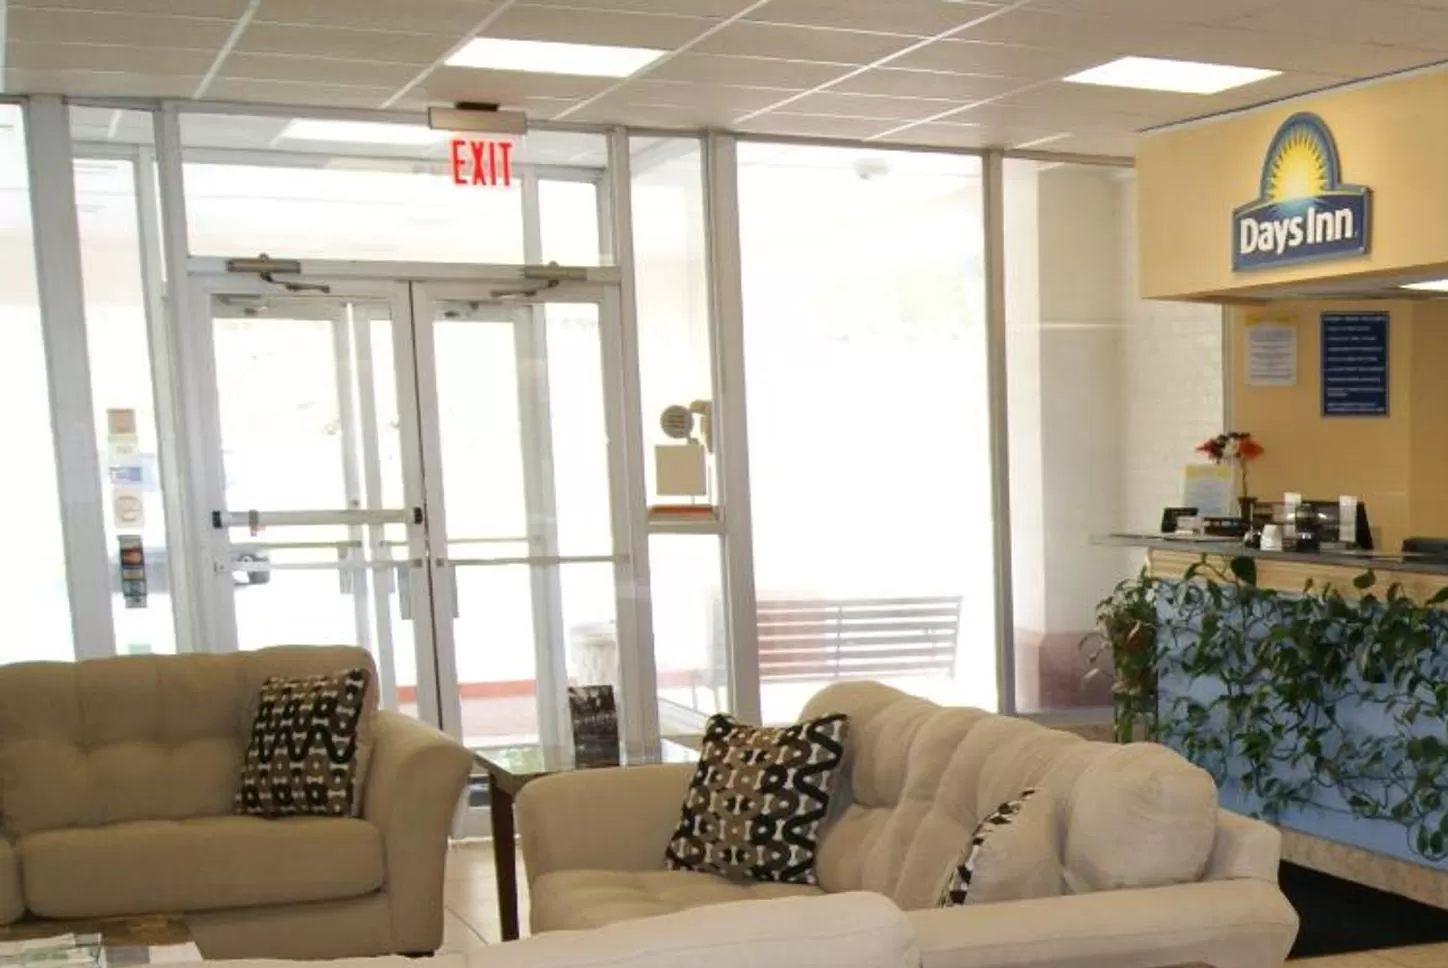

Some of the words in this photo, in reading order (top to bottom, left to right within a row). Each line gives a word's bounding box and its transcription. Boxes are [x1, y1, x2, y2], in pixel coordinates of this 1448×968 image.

[452, 140, 512, 186] EXIT
[1240, 215, 1304, 255] Days
[1306, 206, 1354, 244] Inn
